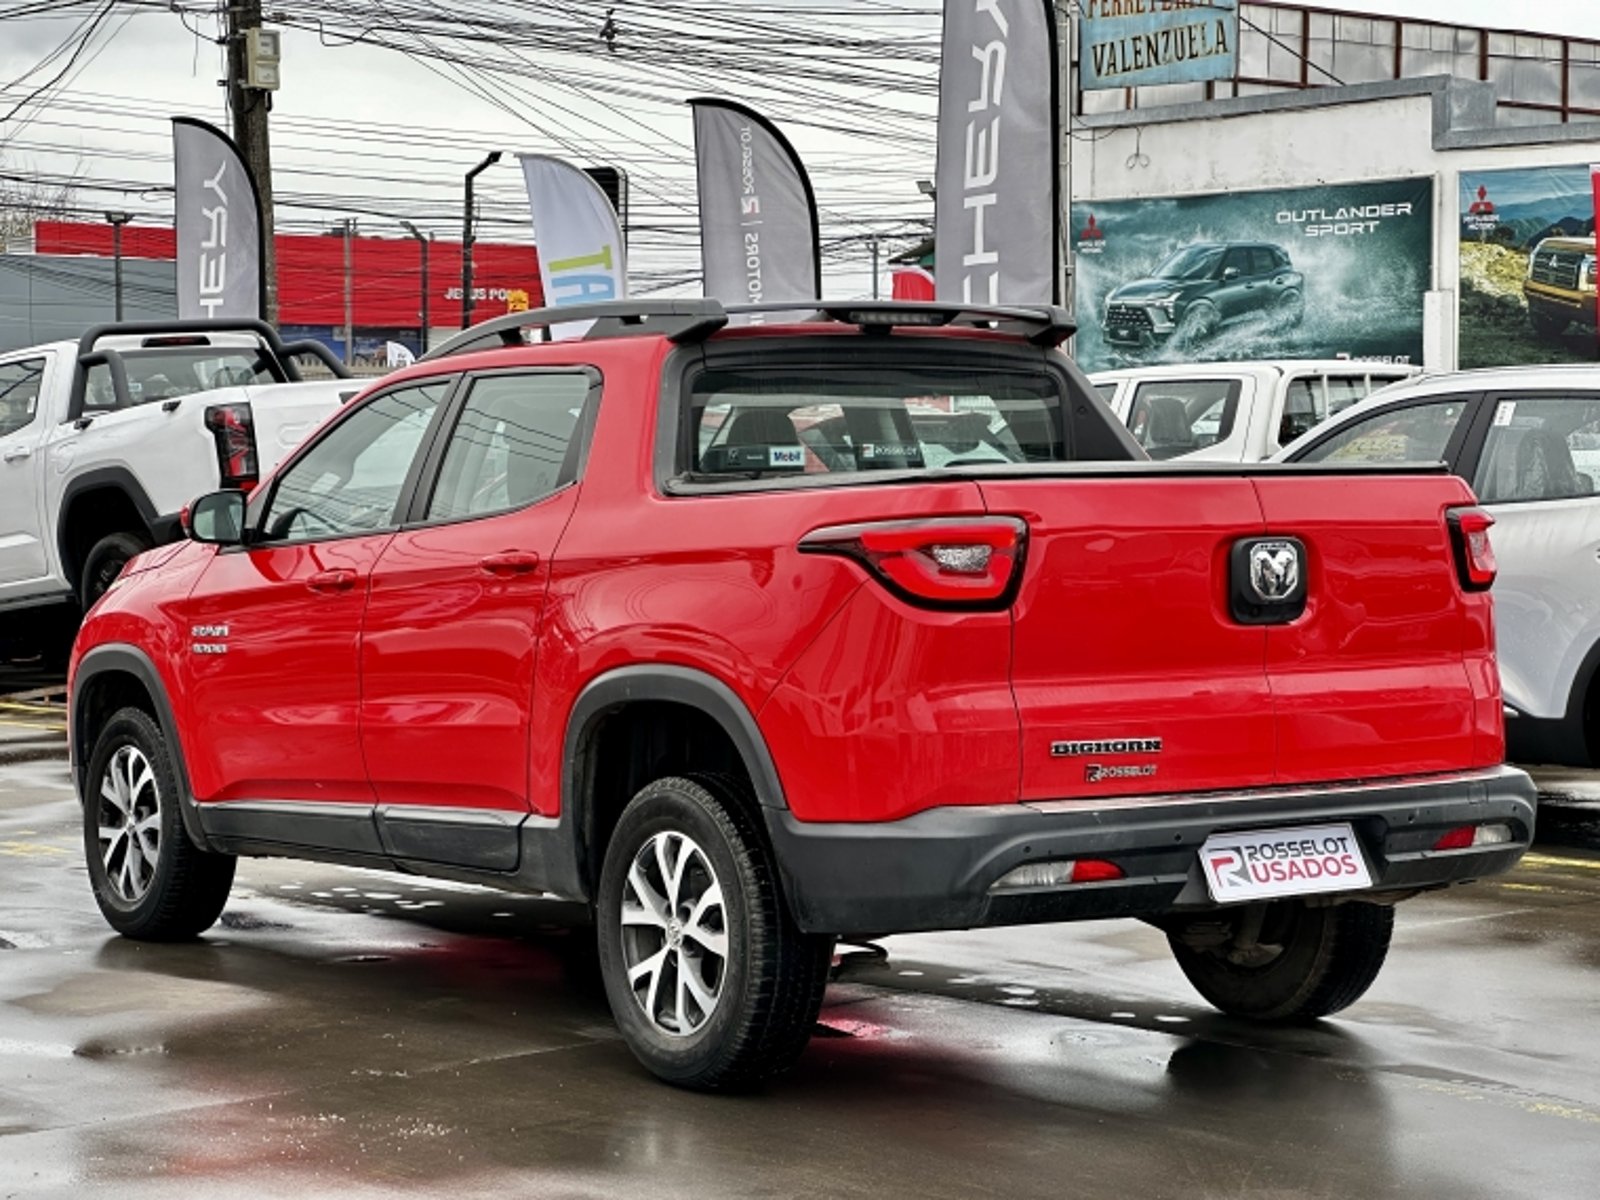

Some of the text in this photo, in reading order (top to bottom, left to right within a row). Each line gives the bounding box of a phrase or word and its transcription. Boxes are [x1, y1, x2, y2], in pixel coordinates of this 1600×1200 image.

[1092, 19, 1228, 77] VALENZUELA
[1276, 202, 1412, 224] OUTLANDER
[1305, 221, 1381, 237] SPORT
[444, 287, 510, 301] JEUS PO
[773, 451, 801, 462] Mobil
[1051, 737, 1162, 756] BIGHORN
[1244, 837, 1349, 862] ROSSELOT
[1251, 855, 1358, 884] USADOS
